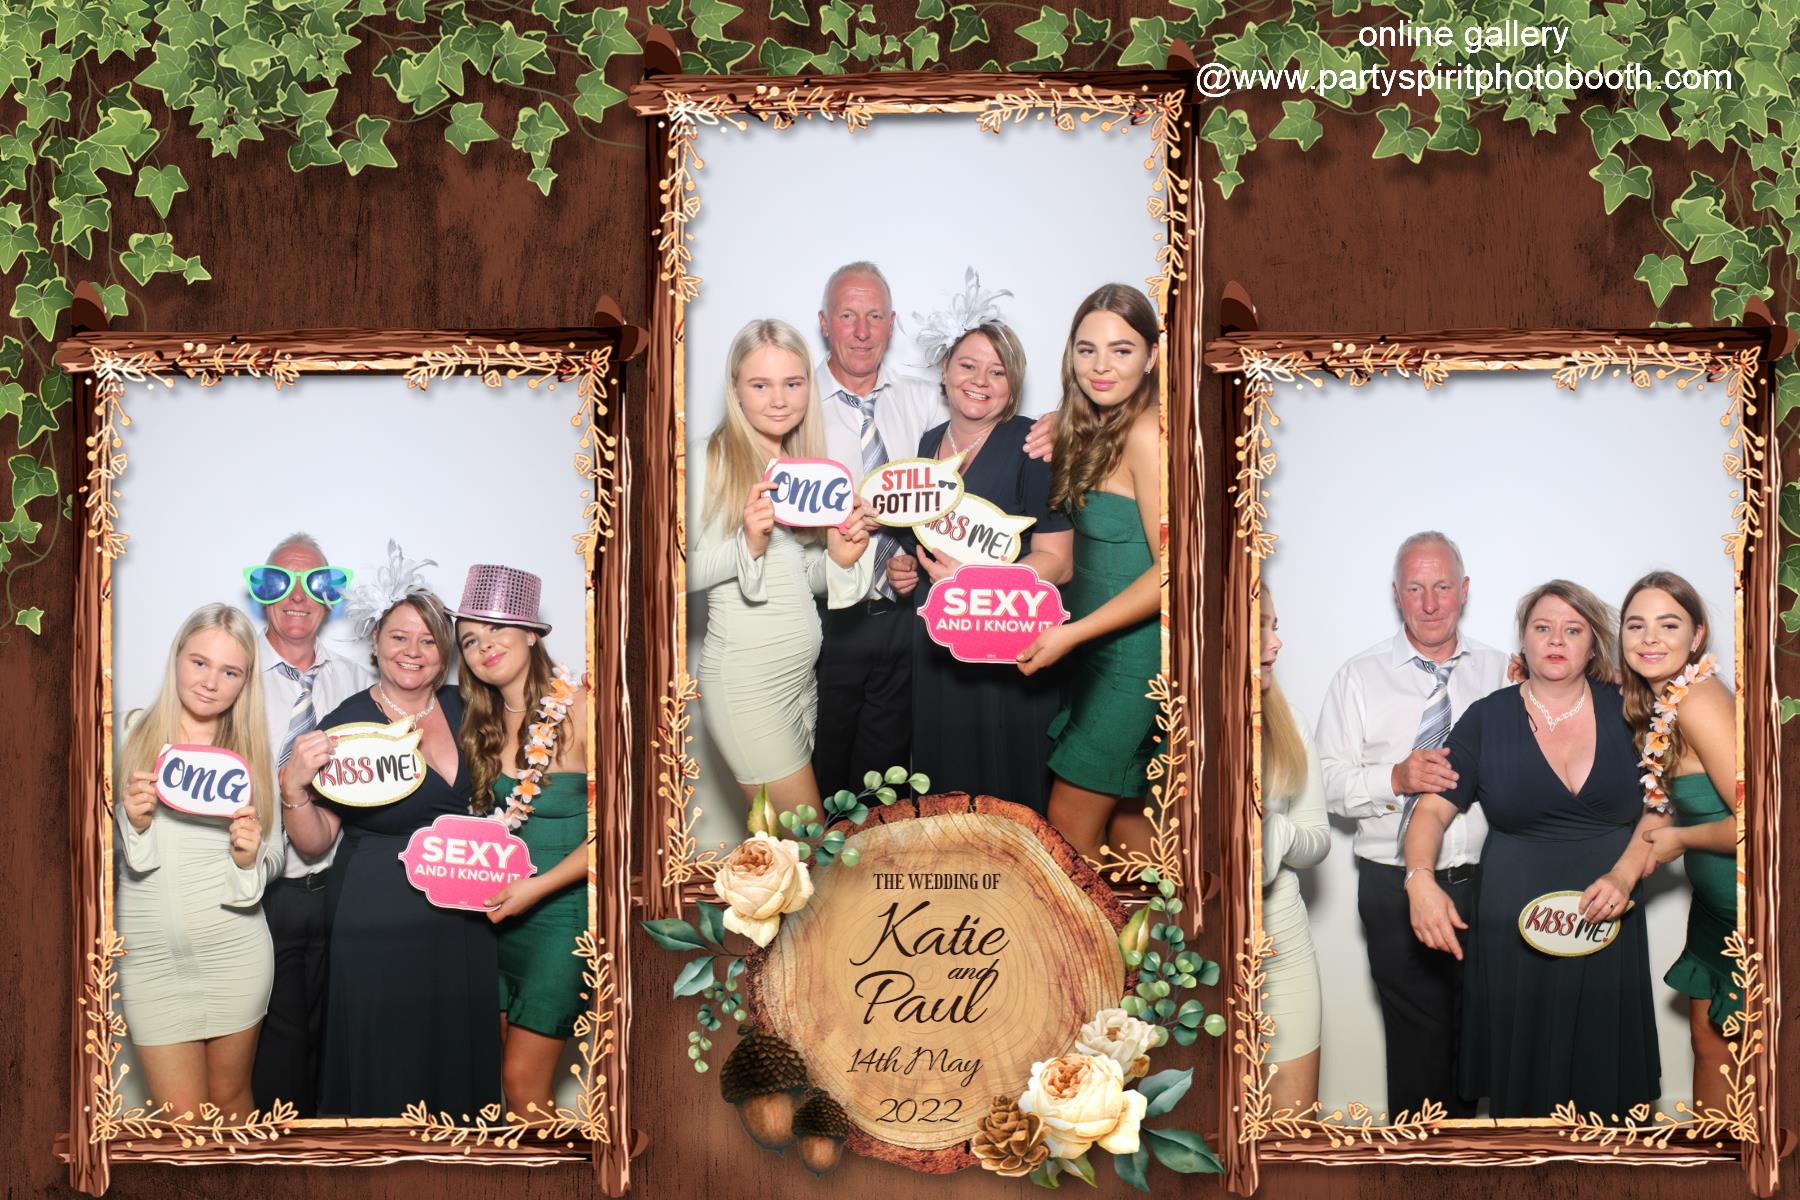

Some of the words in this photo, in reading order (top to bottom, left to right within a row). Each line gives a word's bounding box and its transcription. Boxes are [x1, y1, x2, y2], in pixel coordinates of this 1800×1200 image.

[769, 471, 851, 514] OMG
[881, 467, 936, 491] STILL
[872, 492, 911, 514] GOT
[914, 491, 941, 513] IT!
[967, 523, 1013, 561] ME!
[942, 587, 1049, 617] SEXY
[935, 618, 972, 631] AND
[975, 619, 981, 631] I
[984, 619, 1036, 633] KNOW
[162, 757, 249, 803] OMG
[319, 756, 374, 787] KISS
[376, 753, 421, 783] ME!
[421, 836, 518, 869] SEXY
[414, 863, 448, 877] AND
[450, 868, 455, 878] I
[457, 868, 505, 884] KNOW
[1525, 904, 1577, 936] KISS
[1574, 917, 1615, 943] ME!
